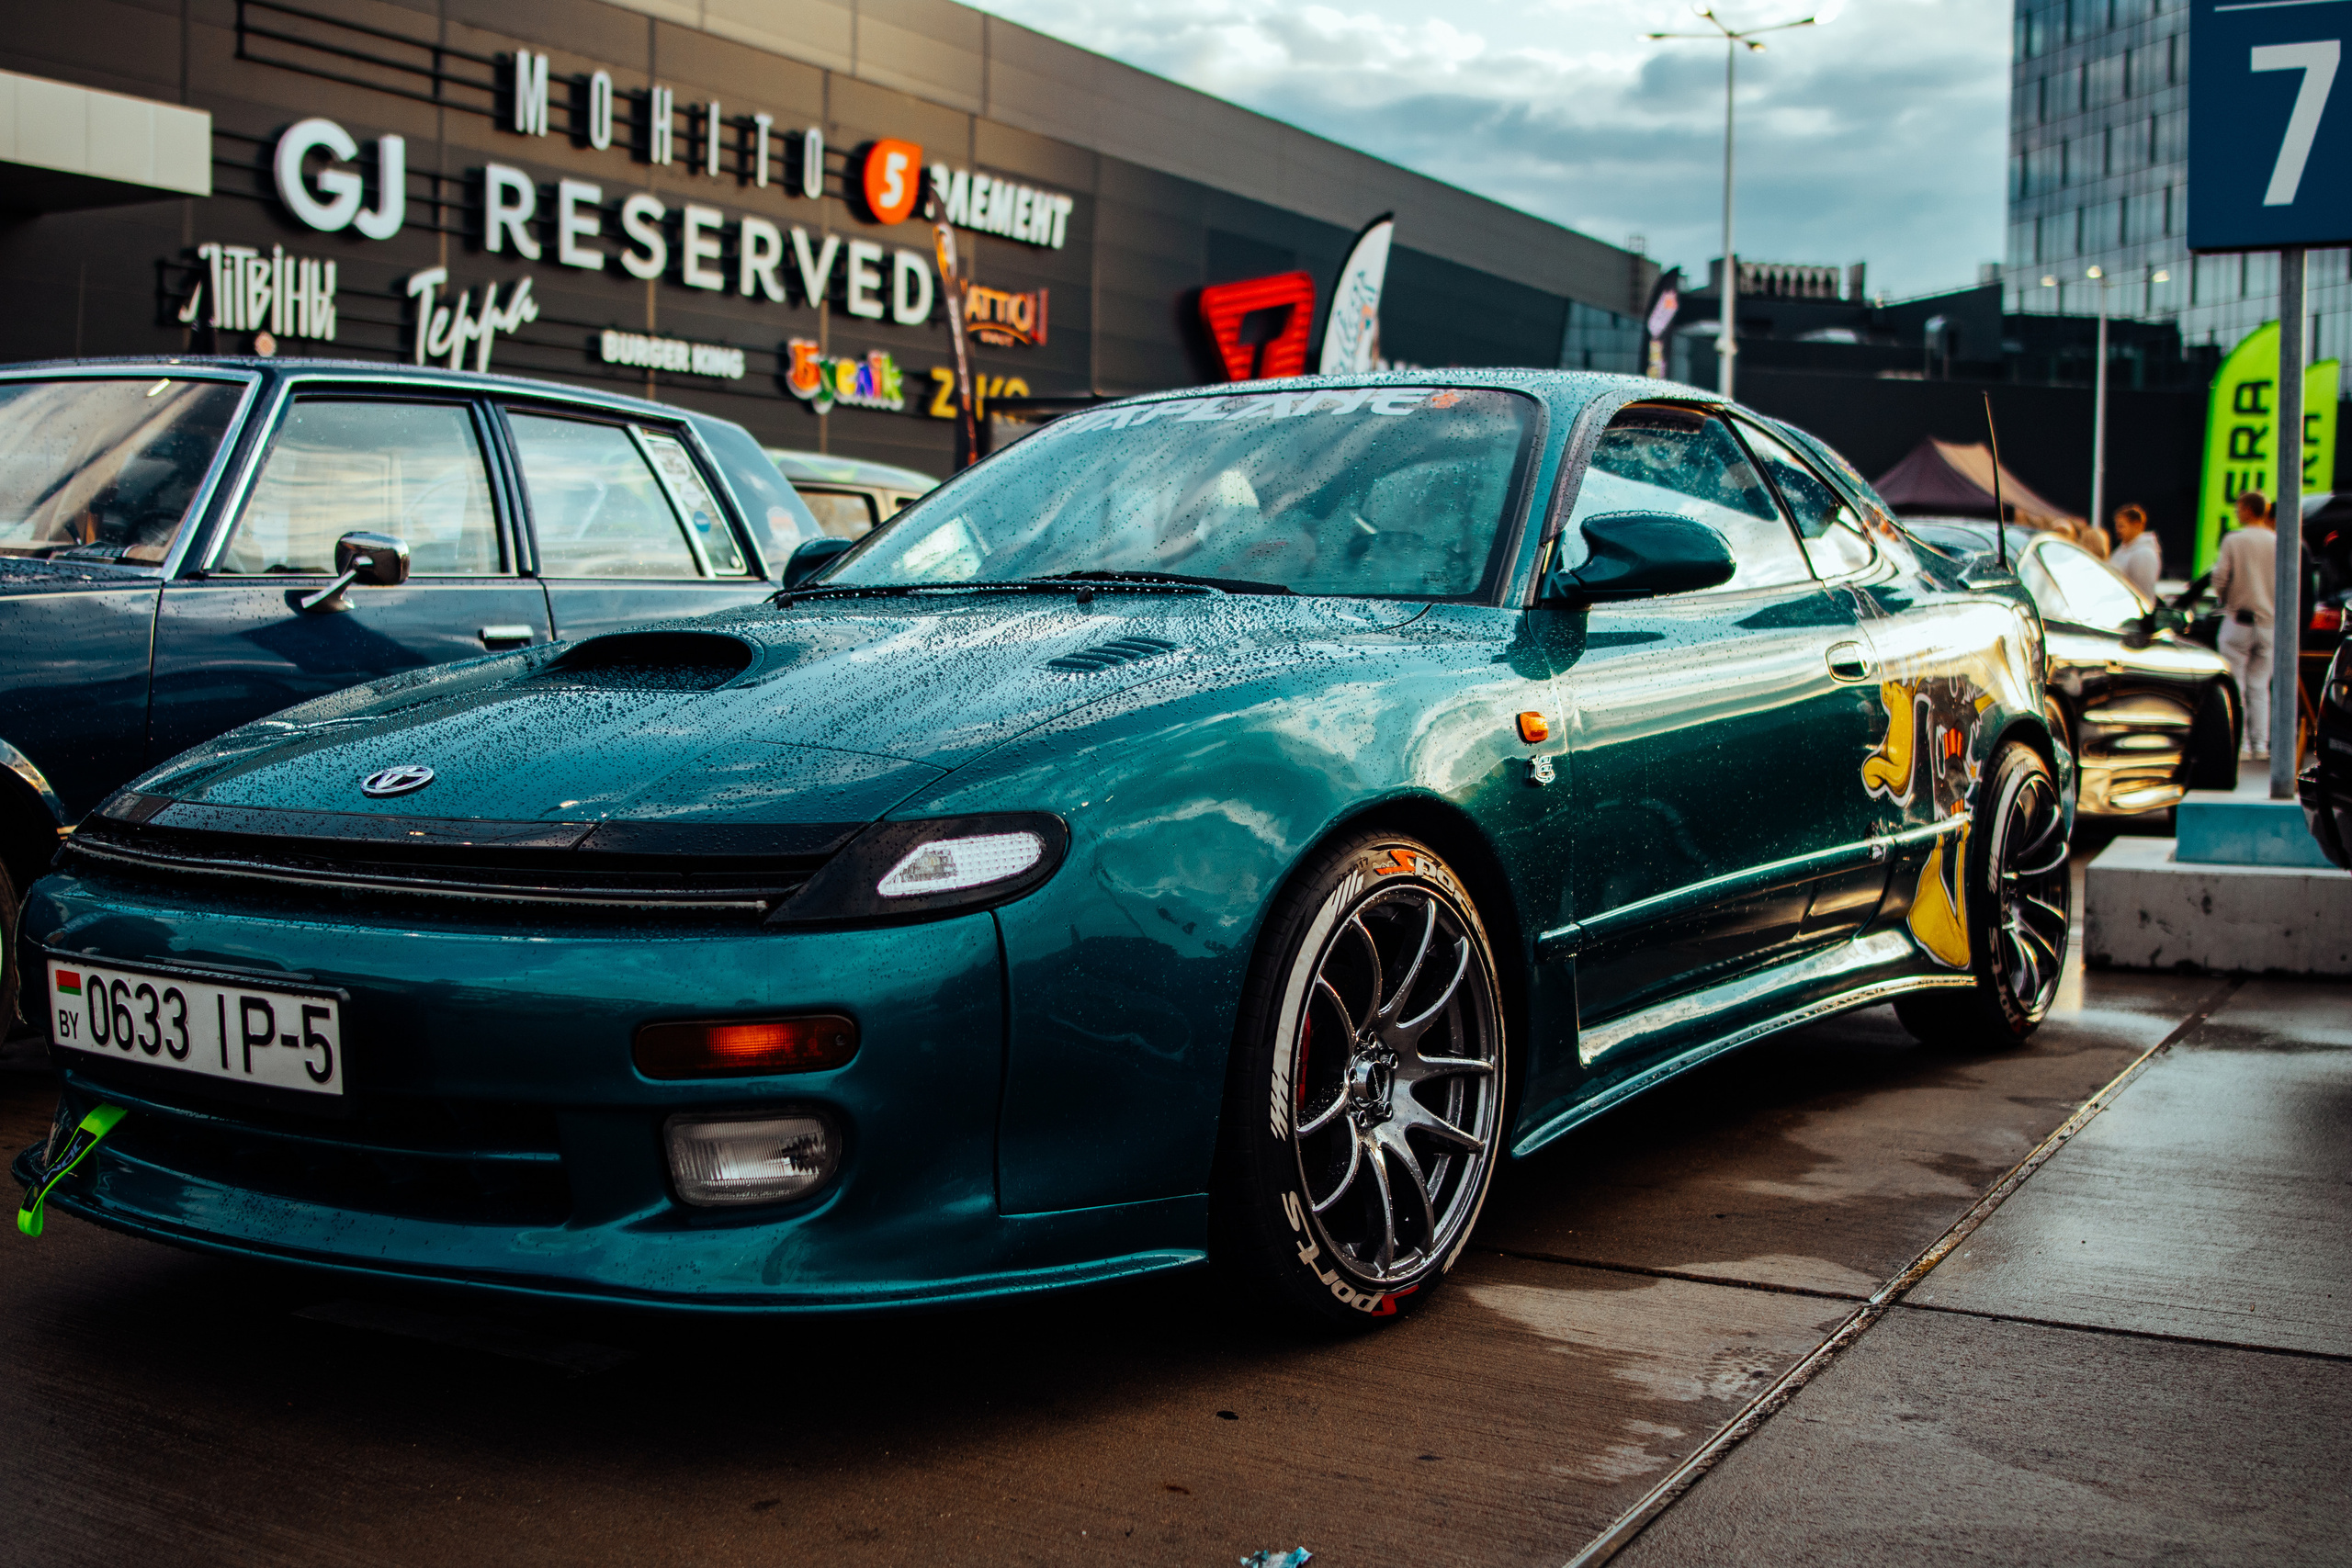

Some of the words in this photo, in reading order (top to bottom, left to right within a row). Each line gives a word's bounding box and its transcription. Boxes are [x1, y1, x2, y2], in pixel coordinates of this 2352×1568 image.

[515, 49, 824, 199] MOHITO
[2251, 39, 2341, 206] 7
[276, 118, 406, 240] GJ
[879, 152, 908, 209] 5
[485, 163, 933, 326] RESERVED
[601, 329, 690, 372] BURGER
[692, 343, 746, 379] KING
[930, 367, 1030, 425] ZKO
[58, 1009, 79, 1040] BY
[86, 974, 191, 1062] 0633
[217, 992, 334, 1085] IP-5
